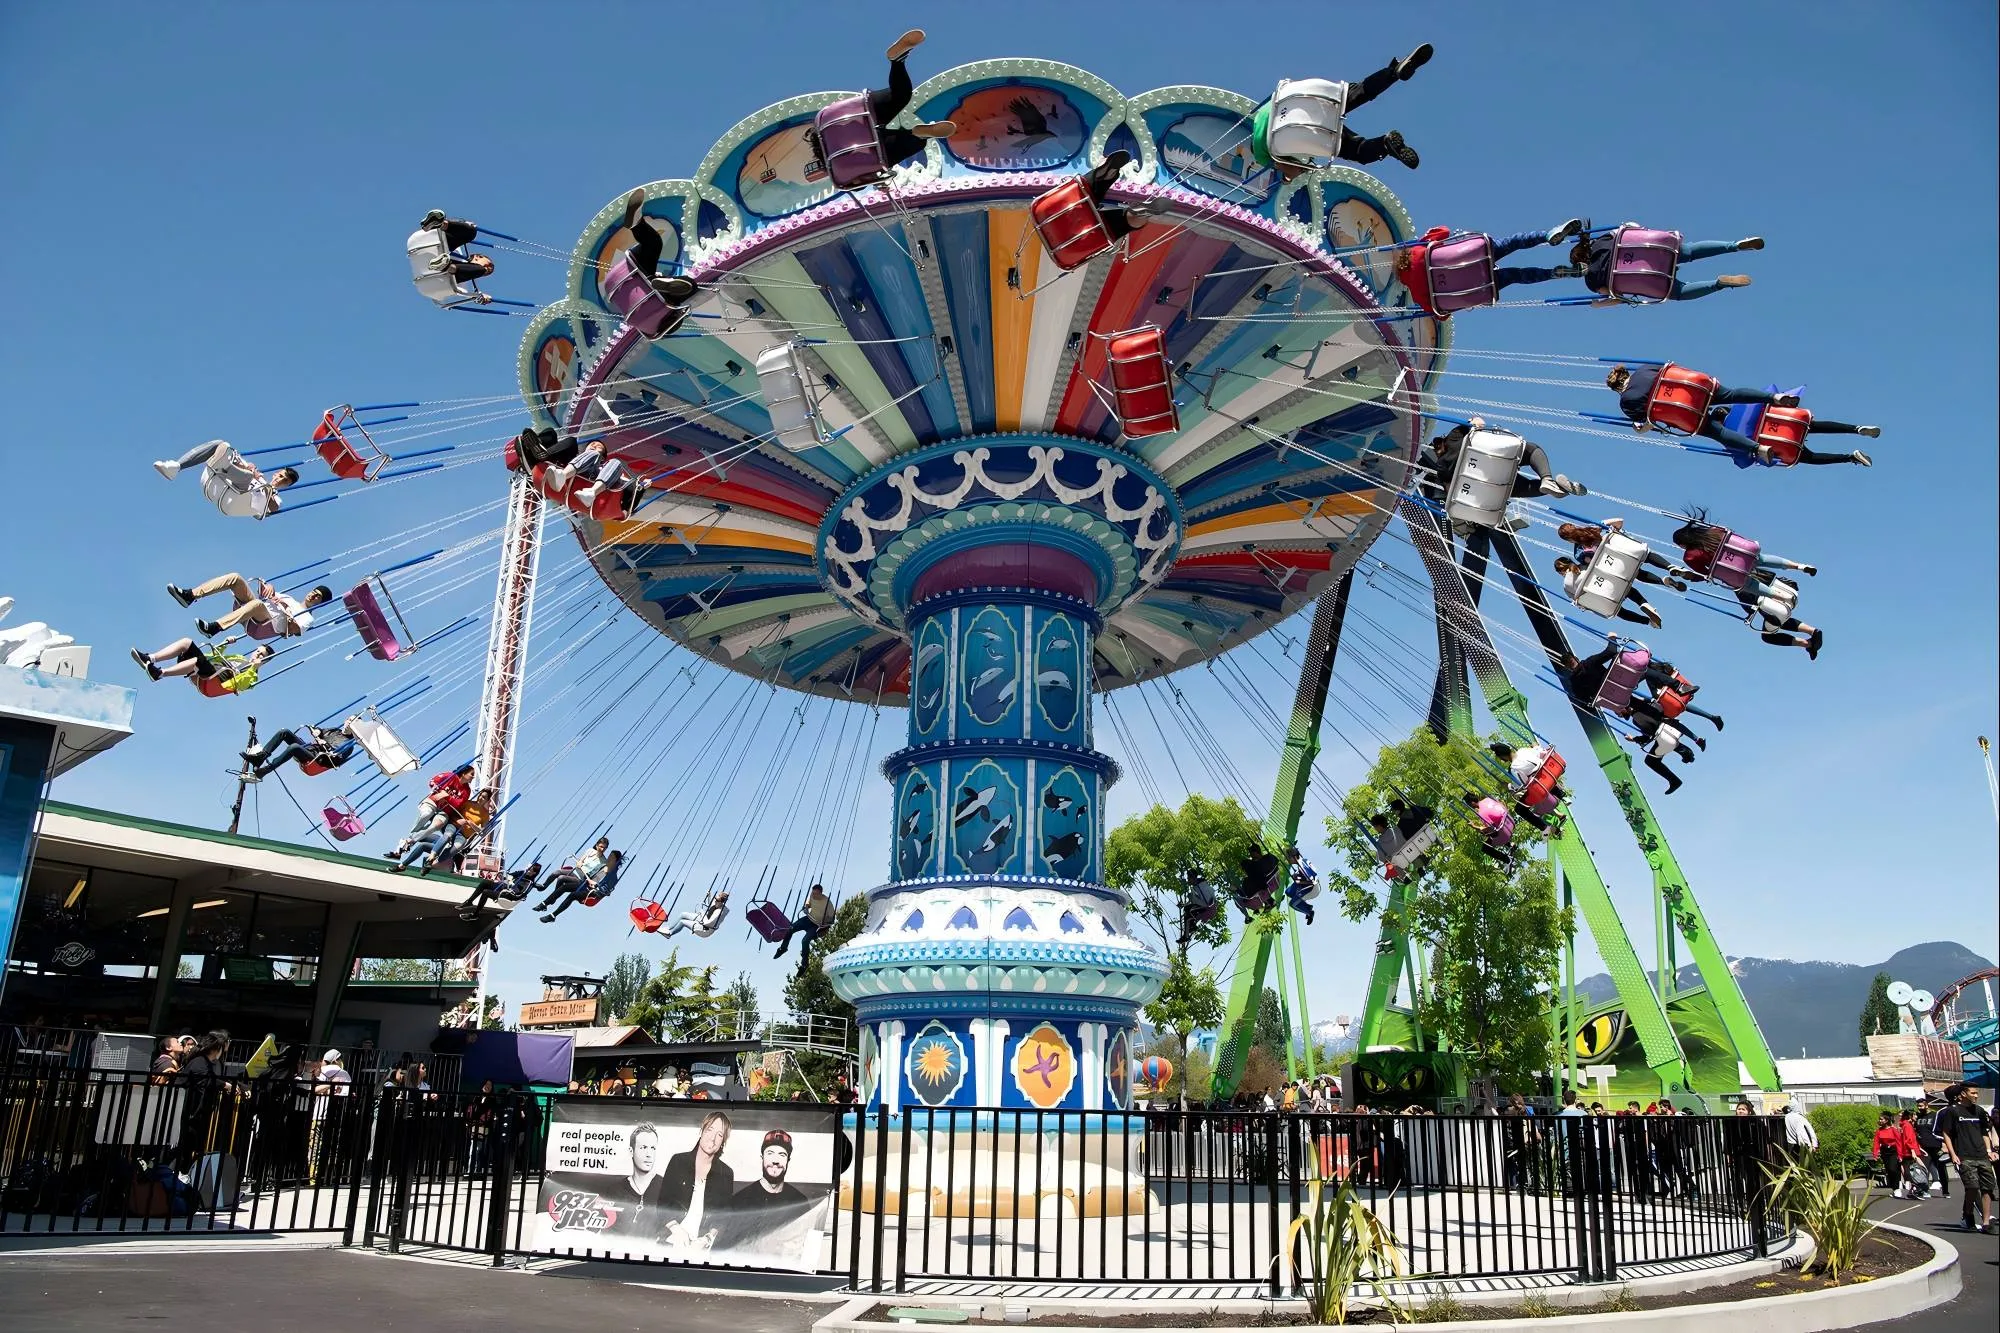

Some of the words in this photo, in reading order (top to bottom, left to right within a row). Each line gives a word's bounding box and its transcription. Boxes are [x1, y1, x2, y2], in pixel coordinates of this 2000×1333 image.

[1623, 251, 1634, 265] 32
[1663, 383, 1675, 398] 29
[1468, 457, 1478, 469] 31
[1461, 483, 1471, 495] 30
[1604, 554, 1615, 567] 27
[1593, 575, 1604, 588] 26
[561, 1129, 582, 1140] real
[584, 1131, 624, 1143] people.
[560, 1142, 581, 1153] real
[584, 1145, 617, 1156] music.
[559, 1157, 580, 1167] real
[582, 1158, 608, 1169] FUN.
